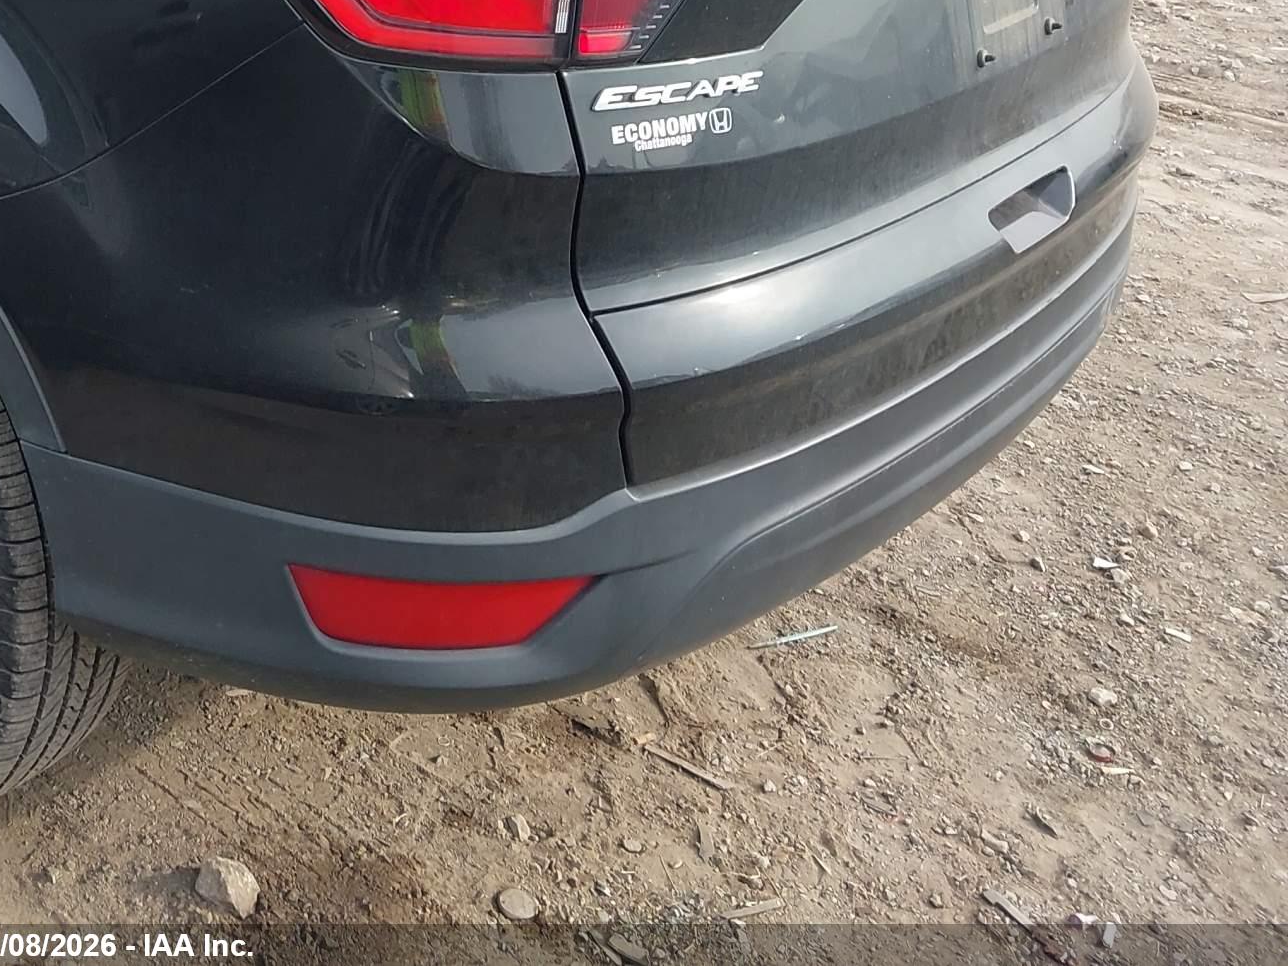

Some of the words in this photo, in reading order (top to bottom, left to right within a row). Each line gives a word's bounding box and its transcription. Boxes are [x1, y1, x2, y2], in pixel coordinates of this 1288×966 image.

[591, 70, 764, 111] ESCAPE
[611, 111, 708, 144] ECONOMY
[634, 132, 693, 152] Chattanooga
